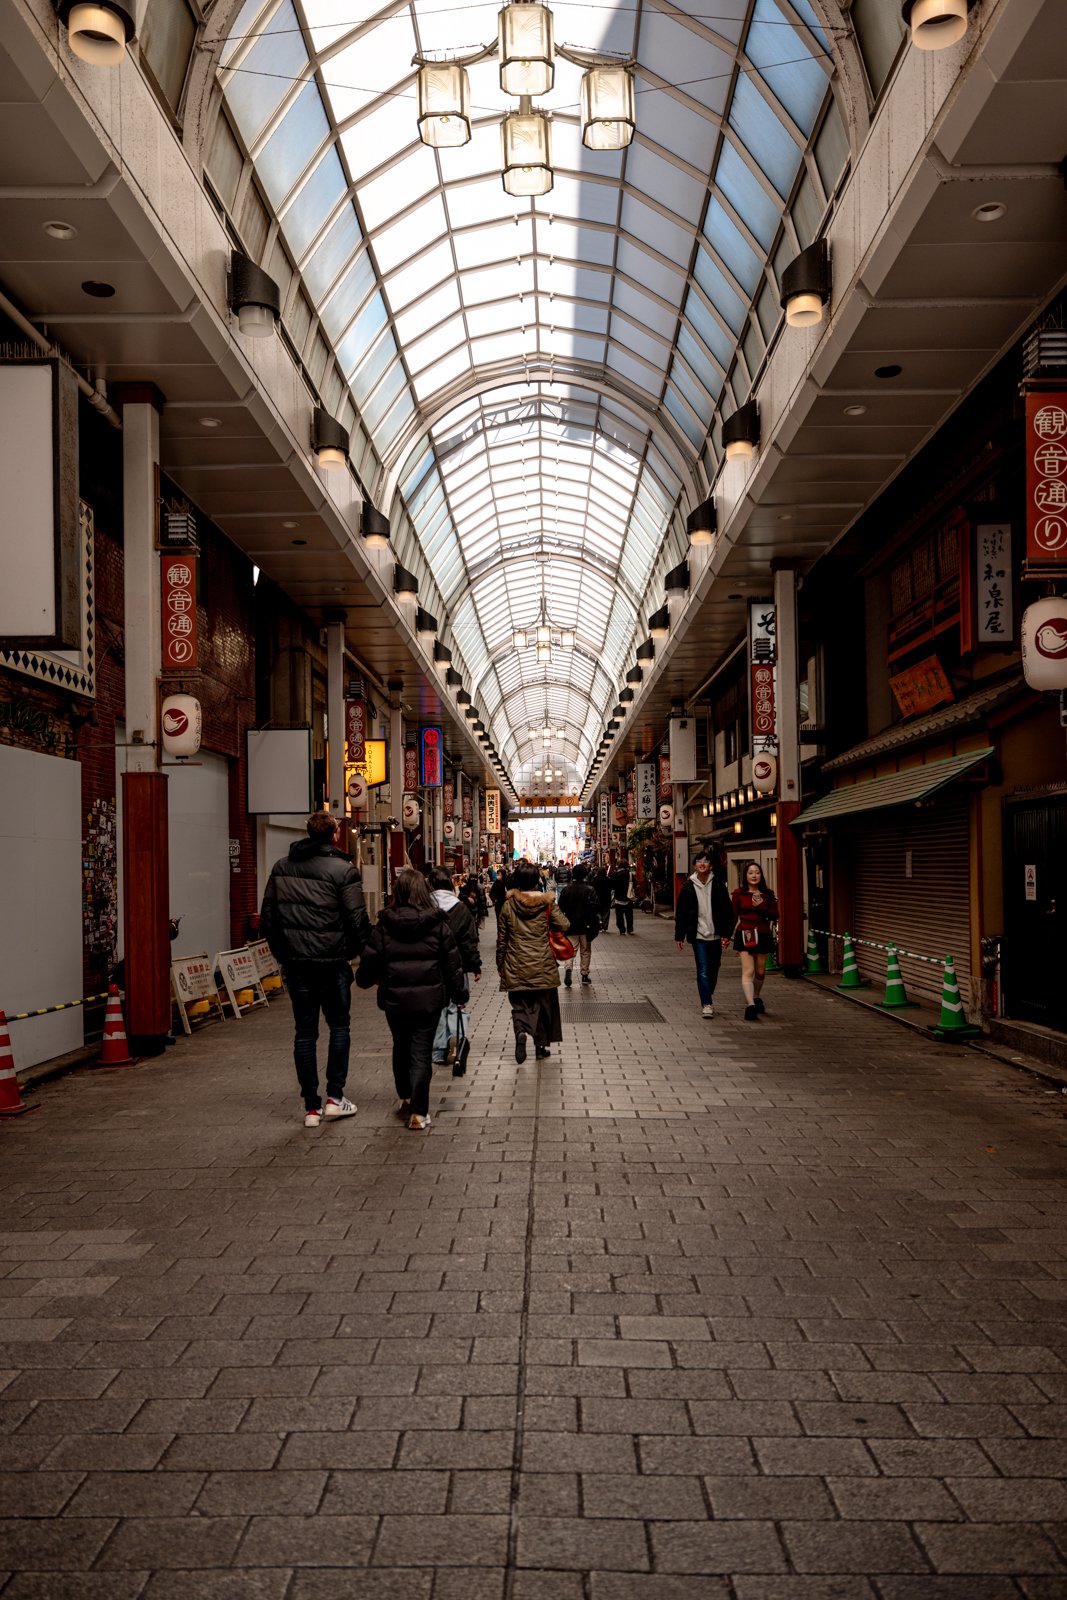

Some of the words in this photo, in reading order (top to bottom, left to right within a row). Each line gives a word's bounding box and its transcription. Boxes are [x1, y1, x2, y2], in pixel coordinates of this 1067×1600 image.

[1033, 405, 1067, 551] 観音通り
[167, 563, 193, 663] 観音通り
[983, 564, 1005, 634] 和泉屋
[349, 705, 364, 759] 観音通り
[755, 668, 772, 731] 観音通り
